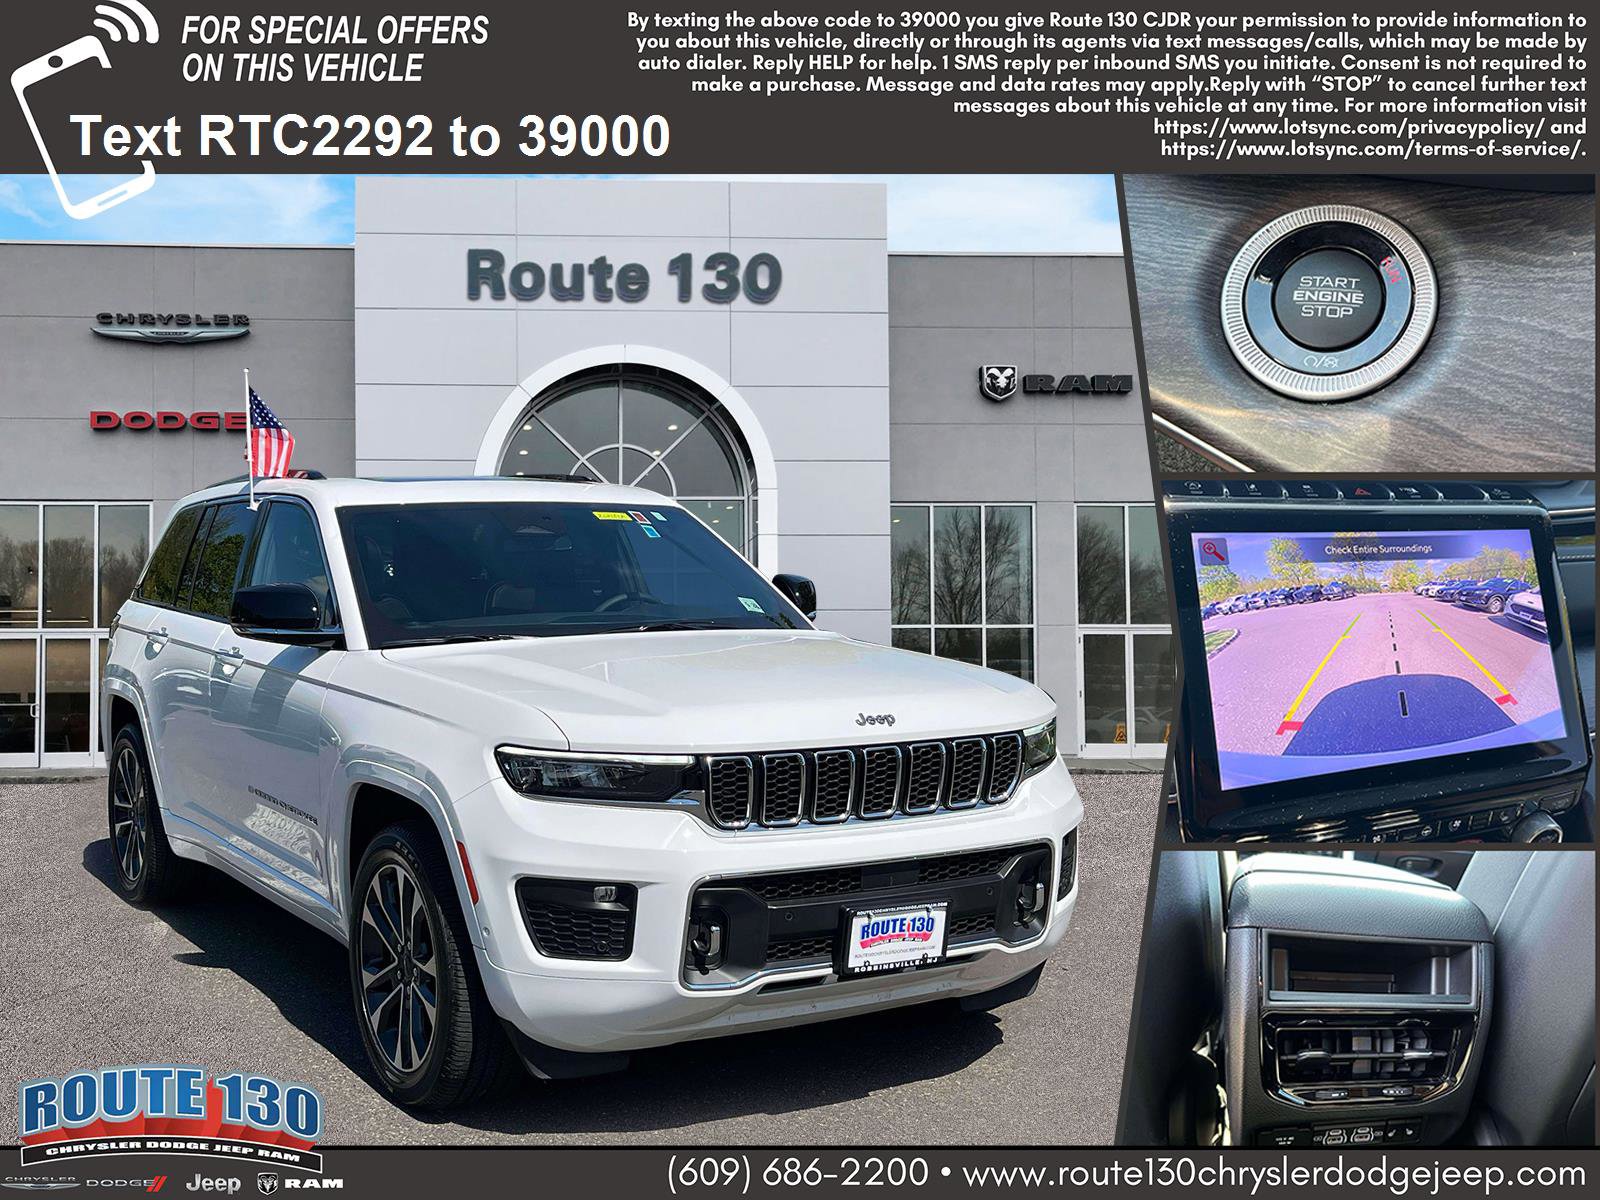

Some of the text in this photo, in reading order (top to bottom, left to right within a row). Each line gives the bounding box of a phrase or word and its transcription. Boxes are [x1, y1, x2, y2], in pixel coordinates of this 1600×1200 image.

[467, 248, 783, 304] Route 130
[1380, 255, 1404, 284] RUN
[1300, 275, 1361, 289] START
[1292, 290, 1365, 304] ENGINE
[1301, 304, 1354, 318] STOP
[96, 312, 250, 326] CHRYSLER
[1023, 374, 1133, 394] RAM
[89, 411, 247, 430] DODGE
[1324, 543, 1433, 555] Check Entire Surroundings
[855, 712, 896, 727] Jeep
[861, 916, 935, 940] ROUTE 130
